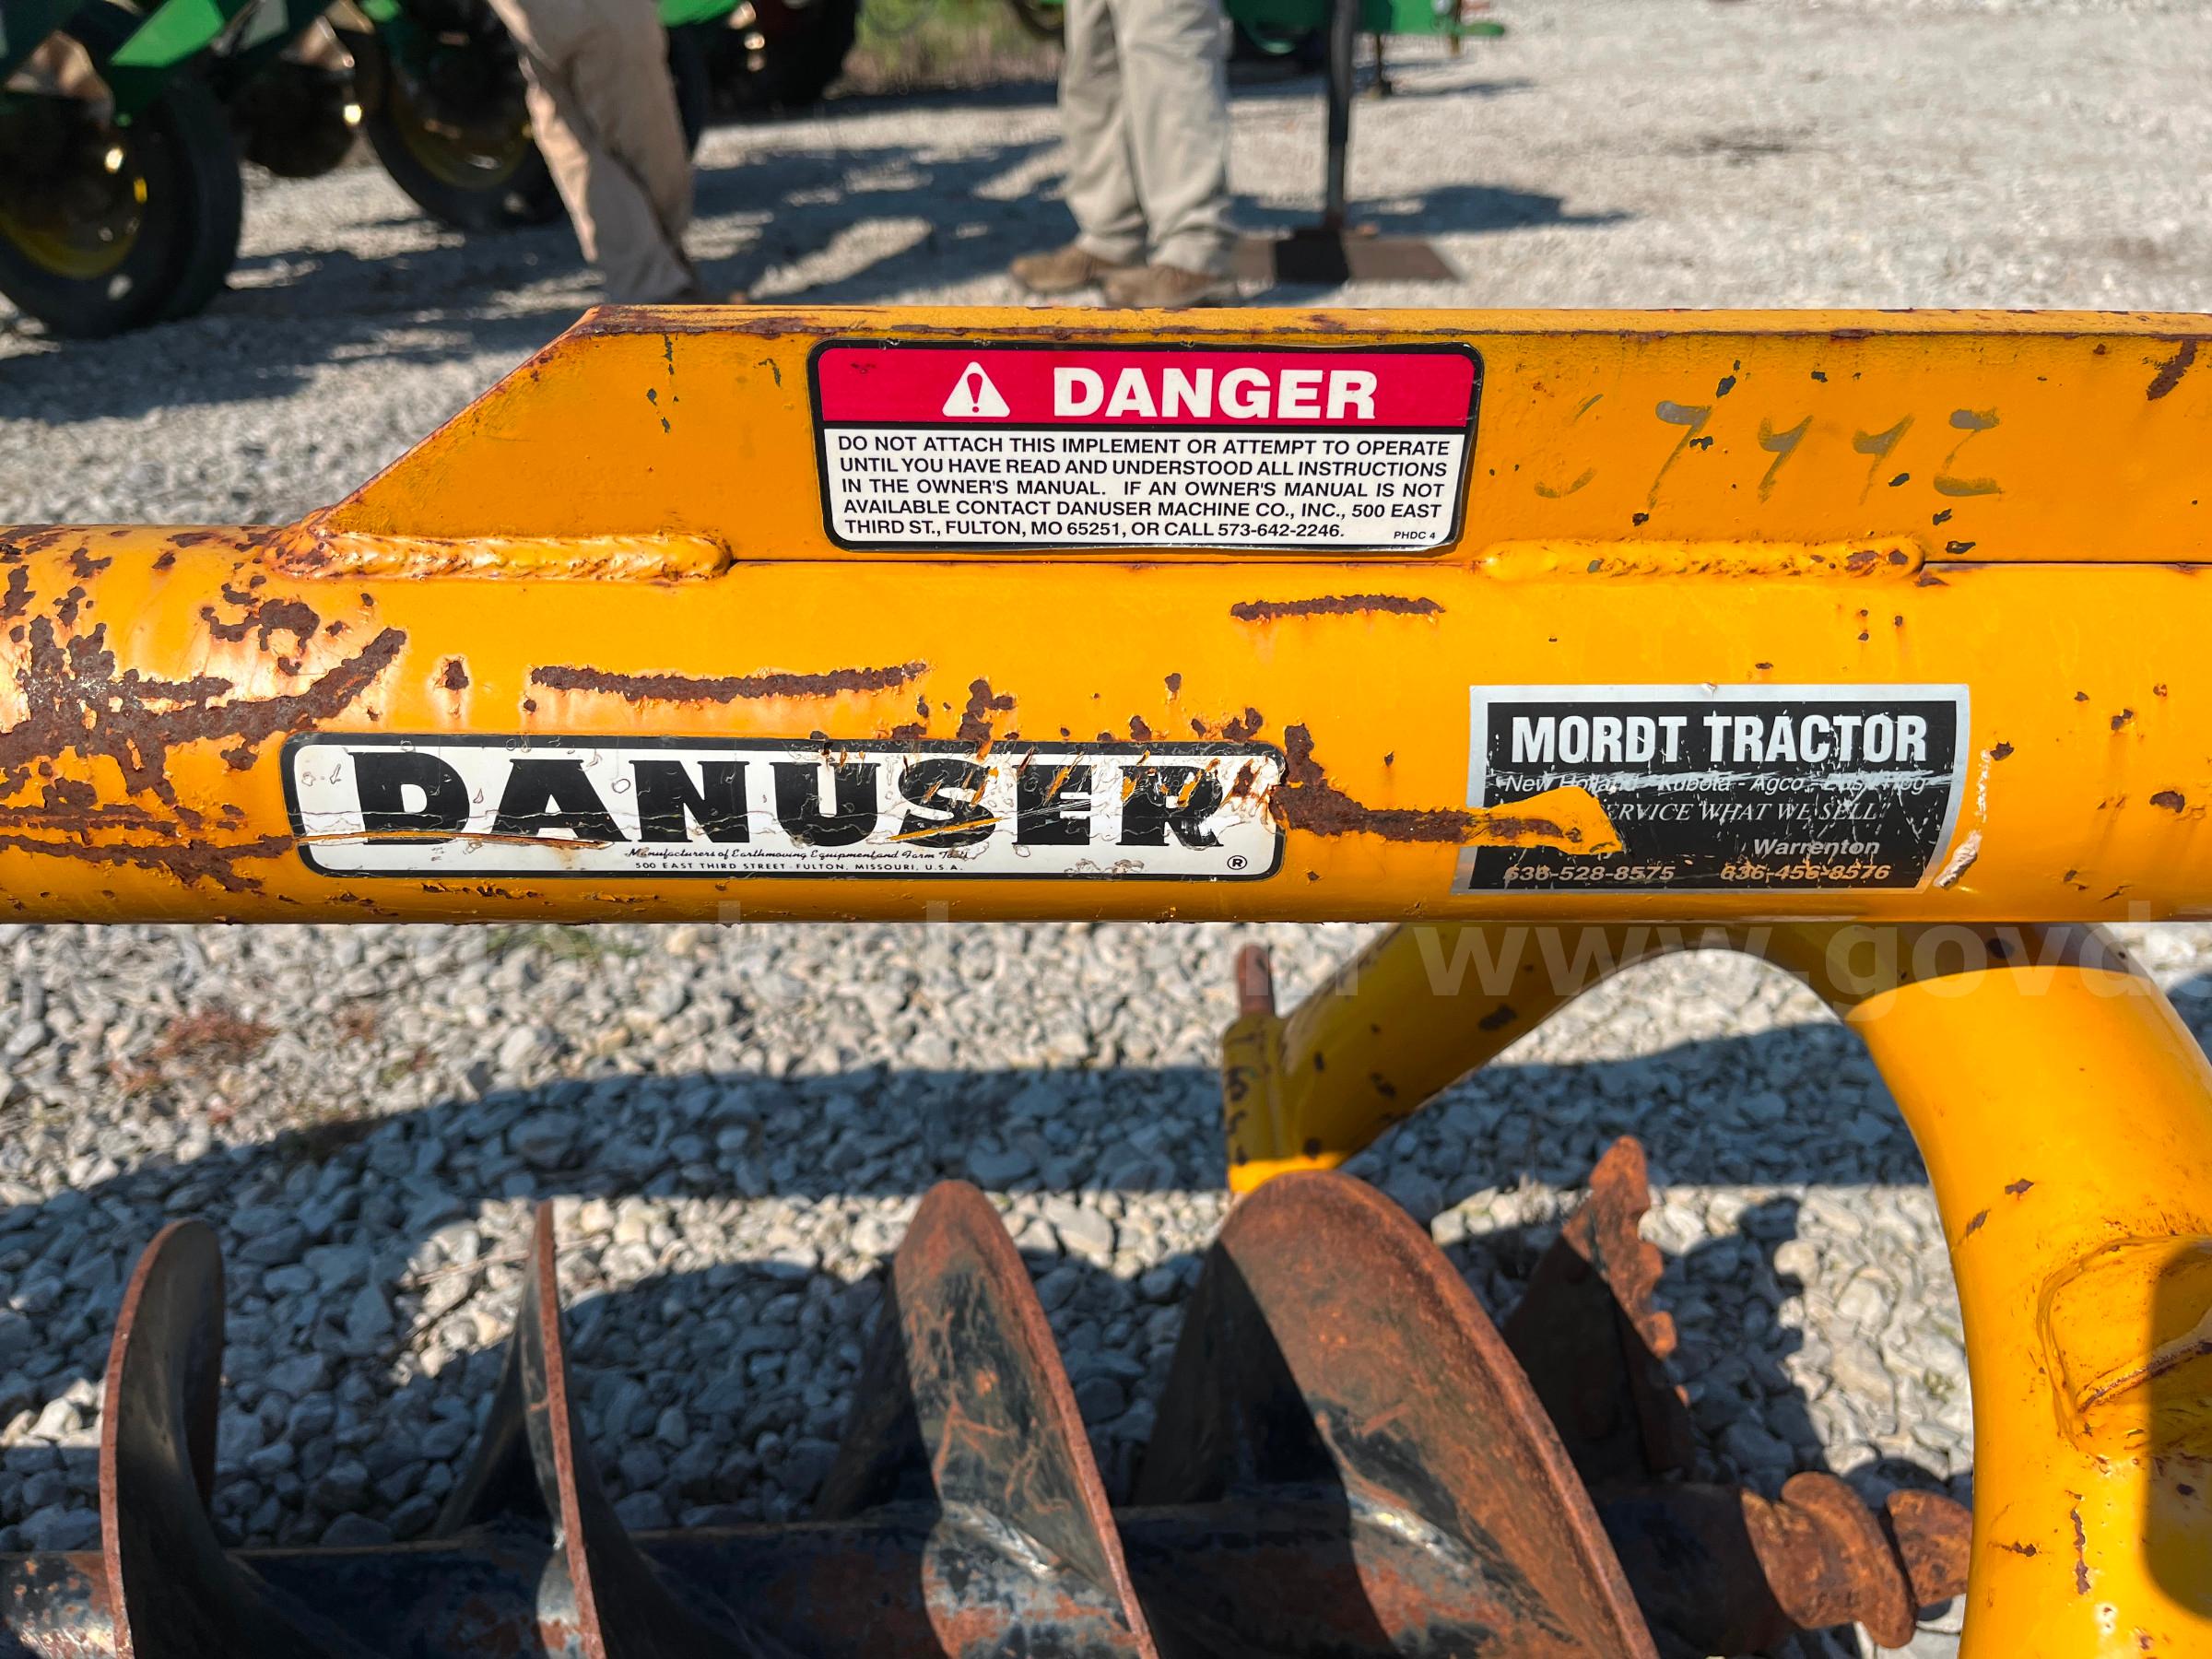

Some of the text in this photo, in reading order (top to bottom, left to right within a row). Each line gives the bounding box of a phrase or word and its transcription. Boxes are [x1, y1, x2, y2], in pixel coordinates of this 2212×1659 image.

[1053, 367, 1378, 420] DANGER
[838, 435, 1451, 456] DO NOT ATTACH THIS IMPLEMENT OR ATTEMPT TO OPERATE
[840, 457, 1447, 477] UNTIL YOU HAVE READ AND UNDERSTOOD ALL INSTRUCTIONS
[841, 478, 1445, 498] IN THE OWNER'S MANUAL. IF AN OWNER'S MANUAL IS NOT
[843, 499, 1442, 521] AVAILABLE CONTACT DANUSER MACHINE CO., INC., 500 EAST
[844, 519, 1345, 538] THIRD ST., FULTON, MO 65251, OR CALL 573-642-2246.
[1394, 531, 1436, 540] PHDC 4
[1511, 714, 1926, 763] MORDT TRACTOR
[1504, 775, 1552, 793] New
[1559, 773, 1639, 793] Holla
[1749, 775, 1804, 794] Agco
[348, 751, 1226, 848] DANUSER
[1602, 803, 1694, 821] ERVICE
[1700, 803, 1772, 821] WHAT
[1777, 803, 1816, 821] WE
[1753, 838, 1880, 856] Warrenton
[635, 862, 657, 870] 500
[662, 862, 693, 870] EAST
[700, 862, 737, 870] THIRD
[743, 862, 785, 870] STREET
